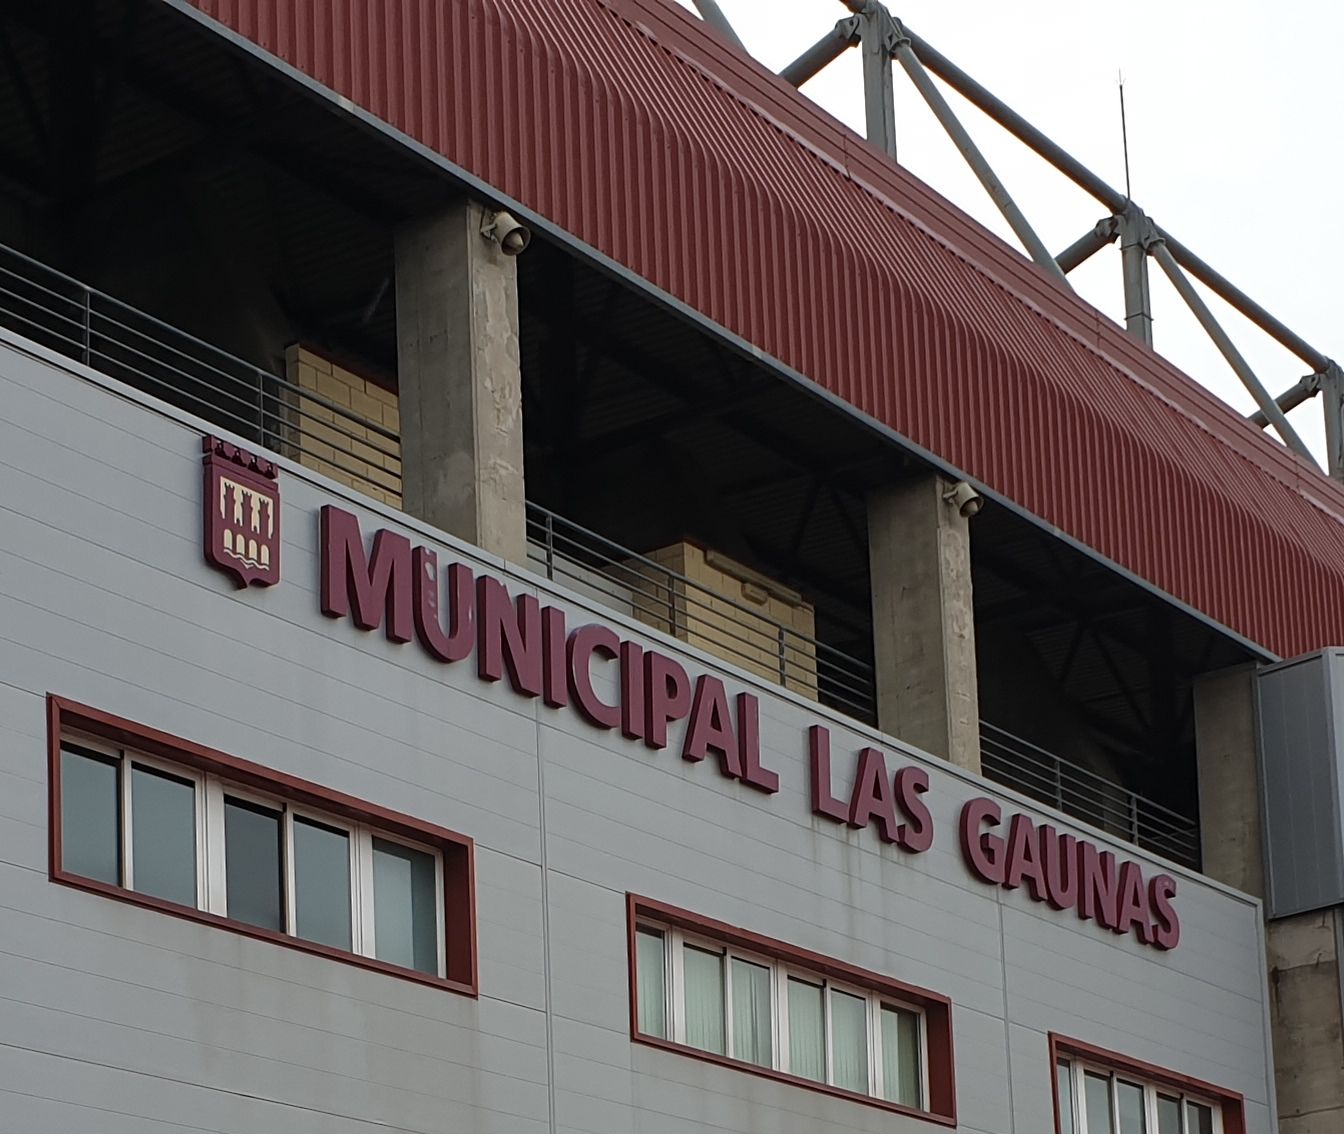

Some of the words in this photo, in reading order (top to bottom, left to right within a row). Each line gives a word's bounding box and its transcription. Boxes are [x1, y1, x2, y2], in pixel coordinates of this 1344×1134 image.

[319, 503, 780, 794] MUNICIPAL
[809, 724, 934, 854] LAS
[959, 796, 1181, 951] GAUNAS
